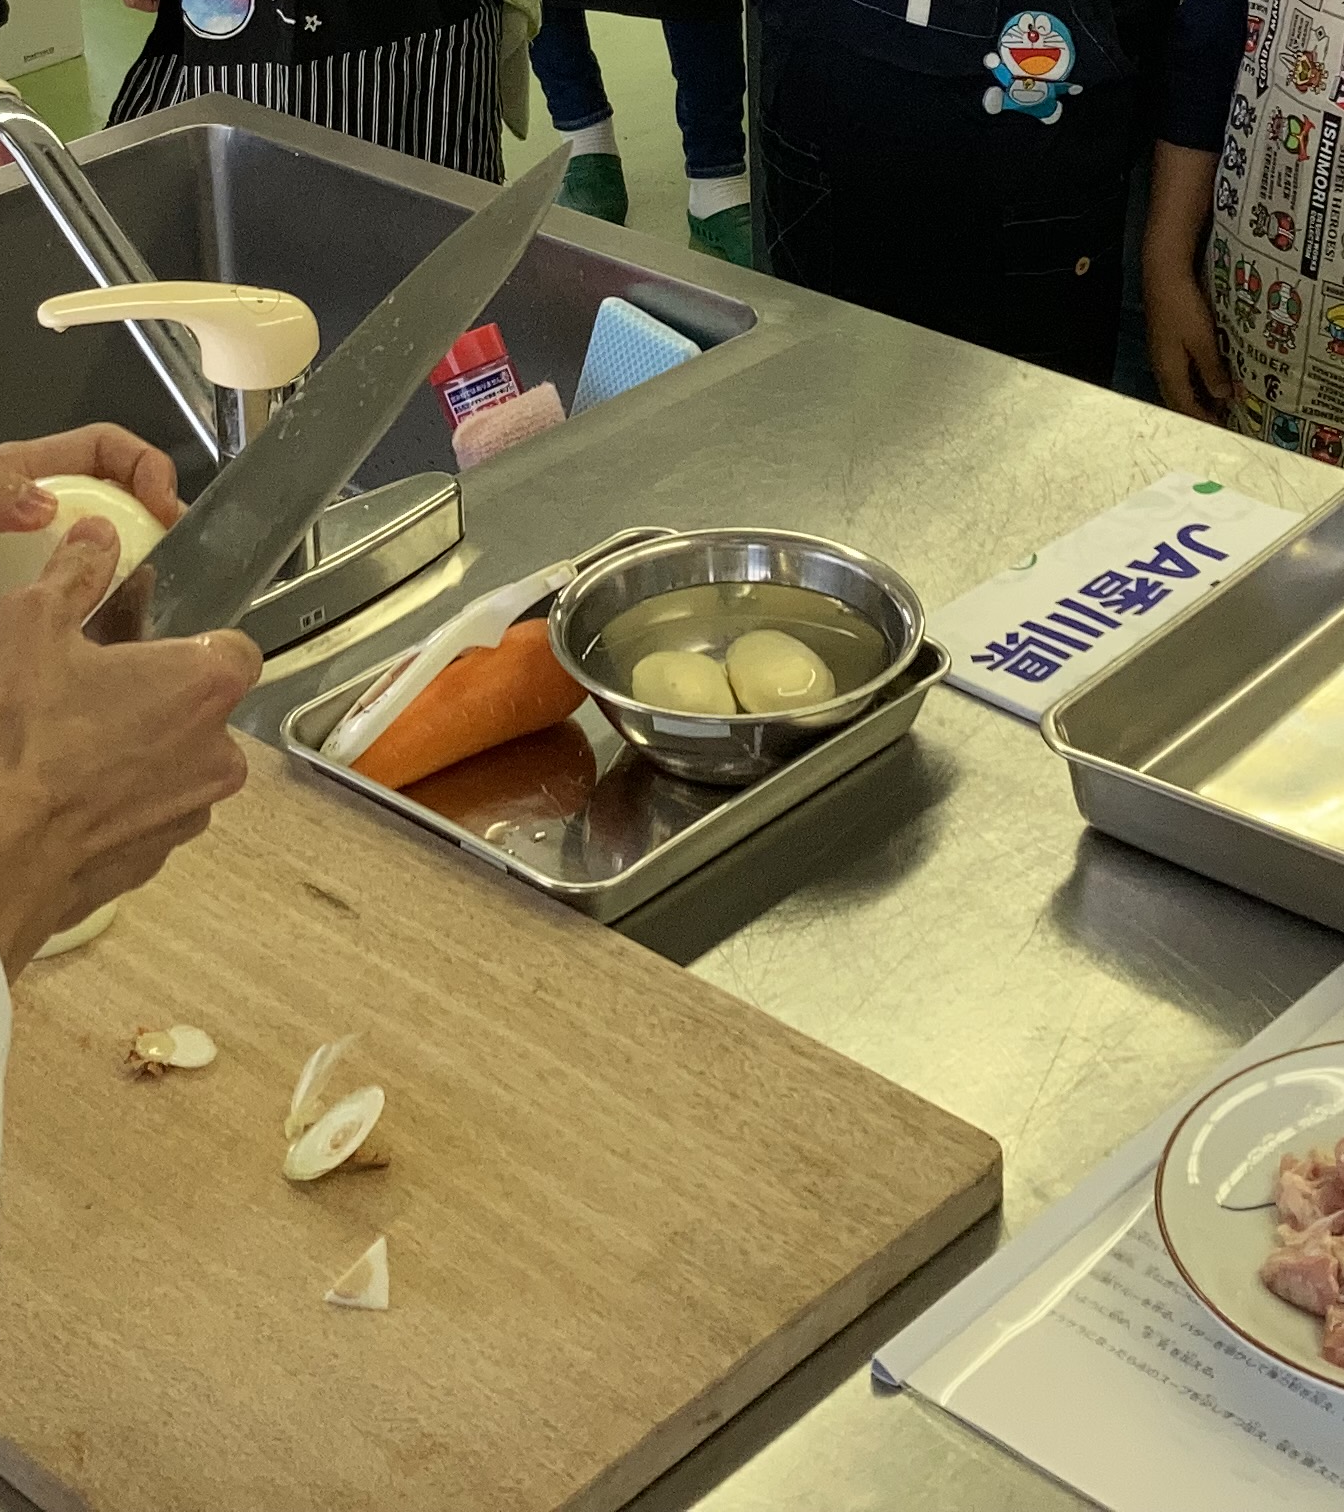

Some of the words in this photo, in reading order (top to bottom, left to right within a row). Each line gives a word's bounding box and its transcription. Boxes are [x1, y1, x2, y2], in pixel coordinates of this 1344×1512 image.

[1258, 33, 1275, 89] COMBAT
[1269, 0, 1281, 31] MAN
[1312, 119, 1338, 210] ISHIMORI
[1325, 197, 1343, 262] HEROES!
[1246, 344, 1291, 376] RIDER
[970, 523, 1230, 683] JA香川県
